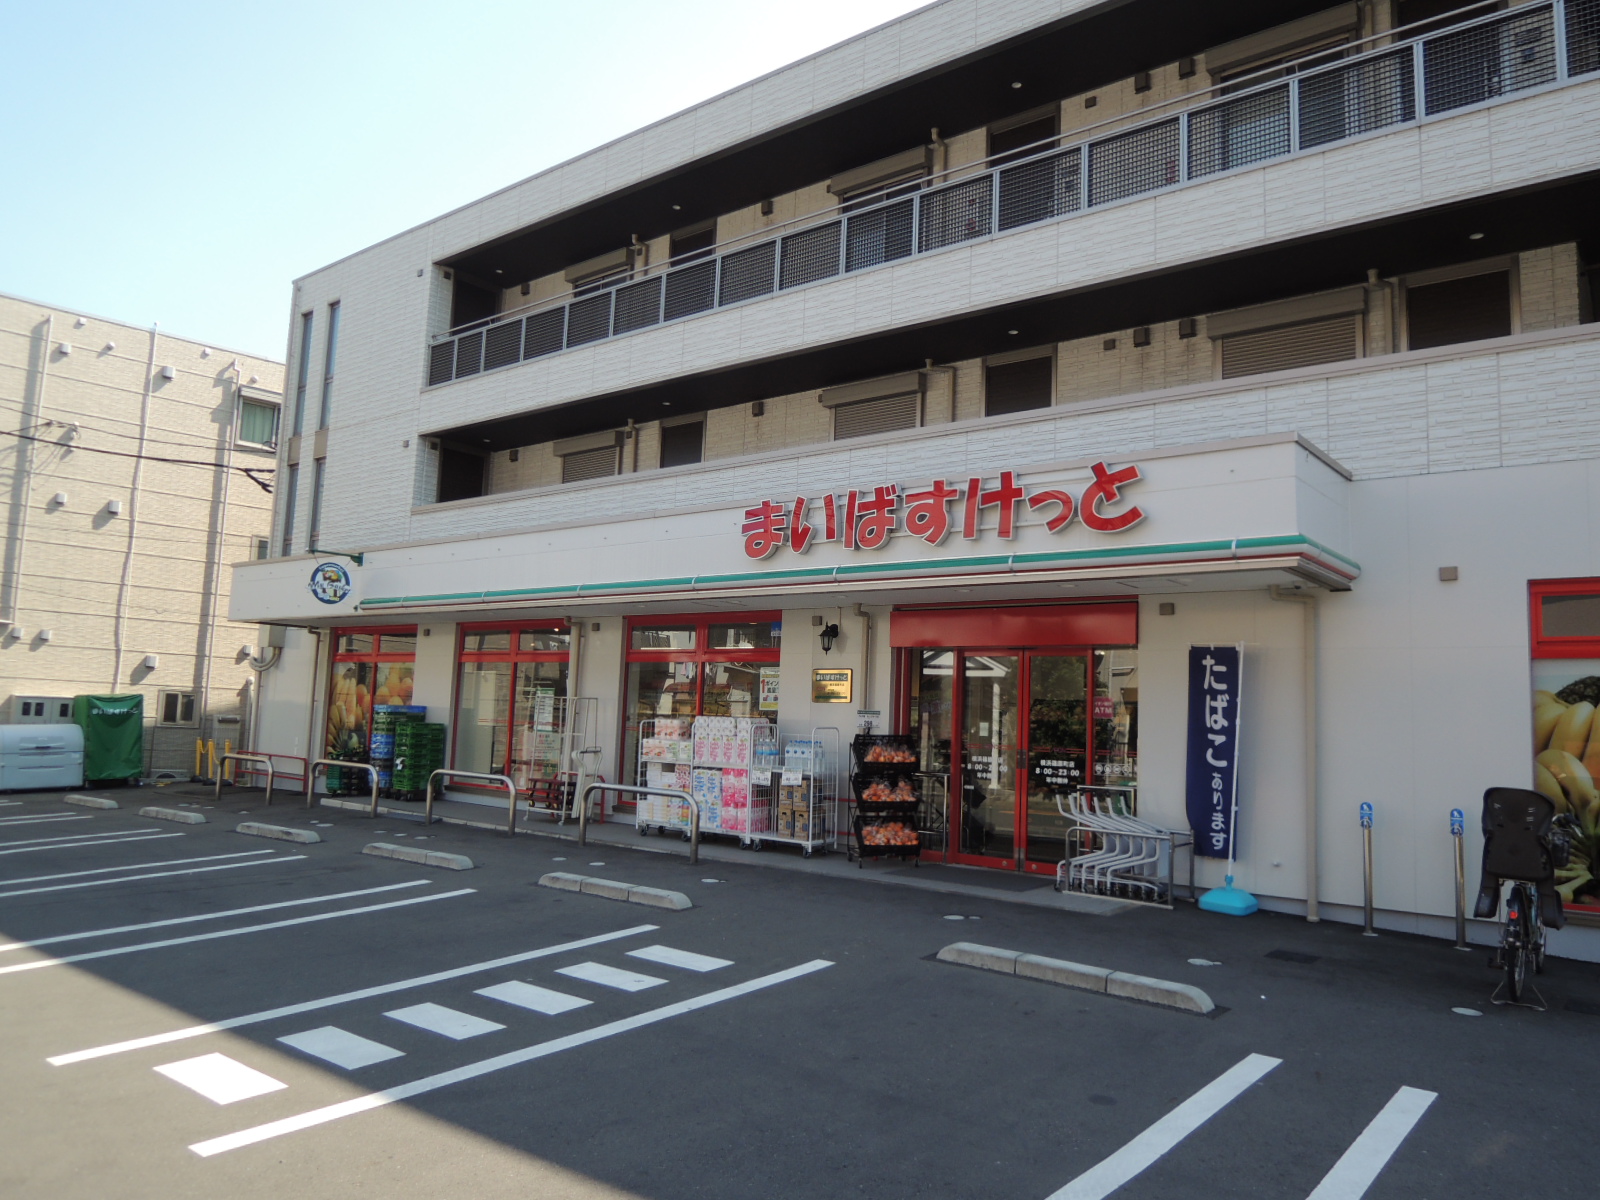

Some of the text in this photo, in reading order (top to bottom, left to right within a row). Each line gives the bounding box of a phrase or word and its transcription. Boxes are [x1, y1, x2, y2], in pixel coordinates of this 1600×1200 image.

[741, 461, 1144, 560] まいばすけっと
